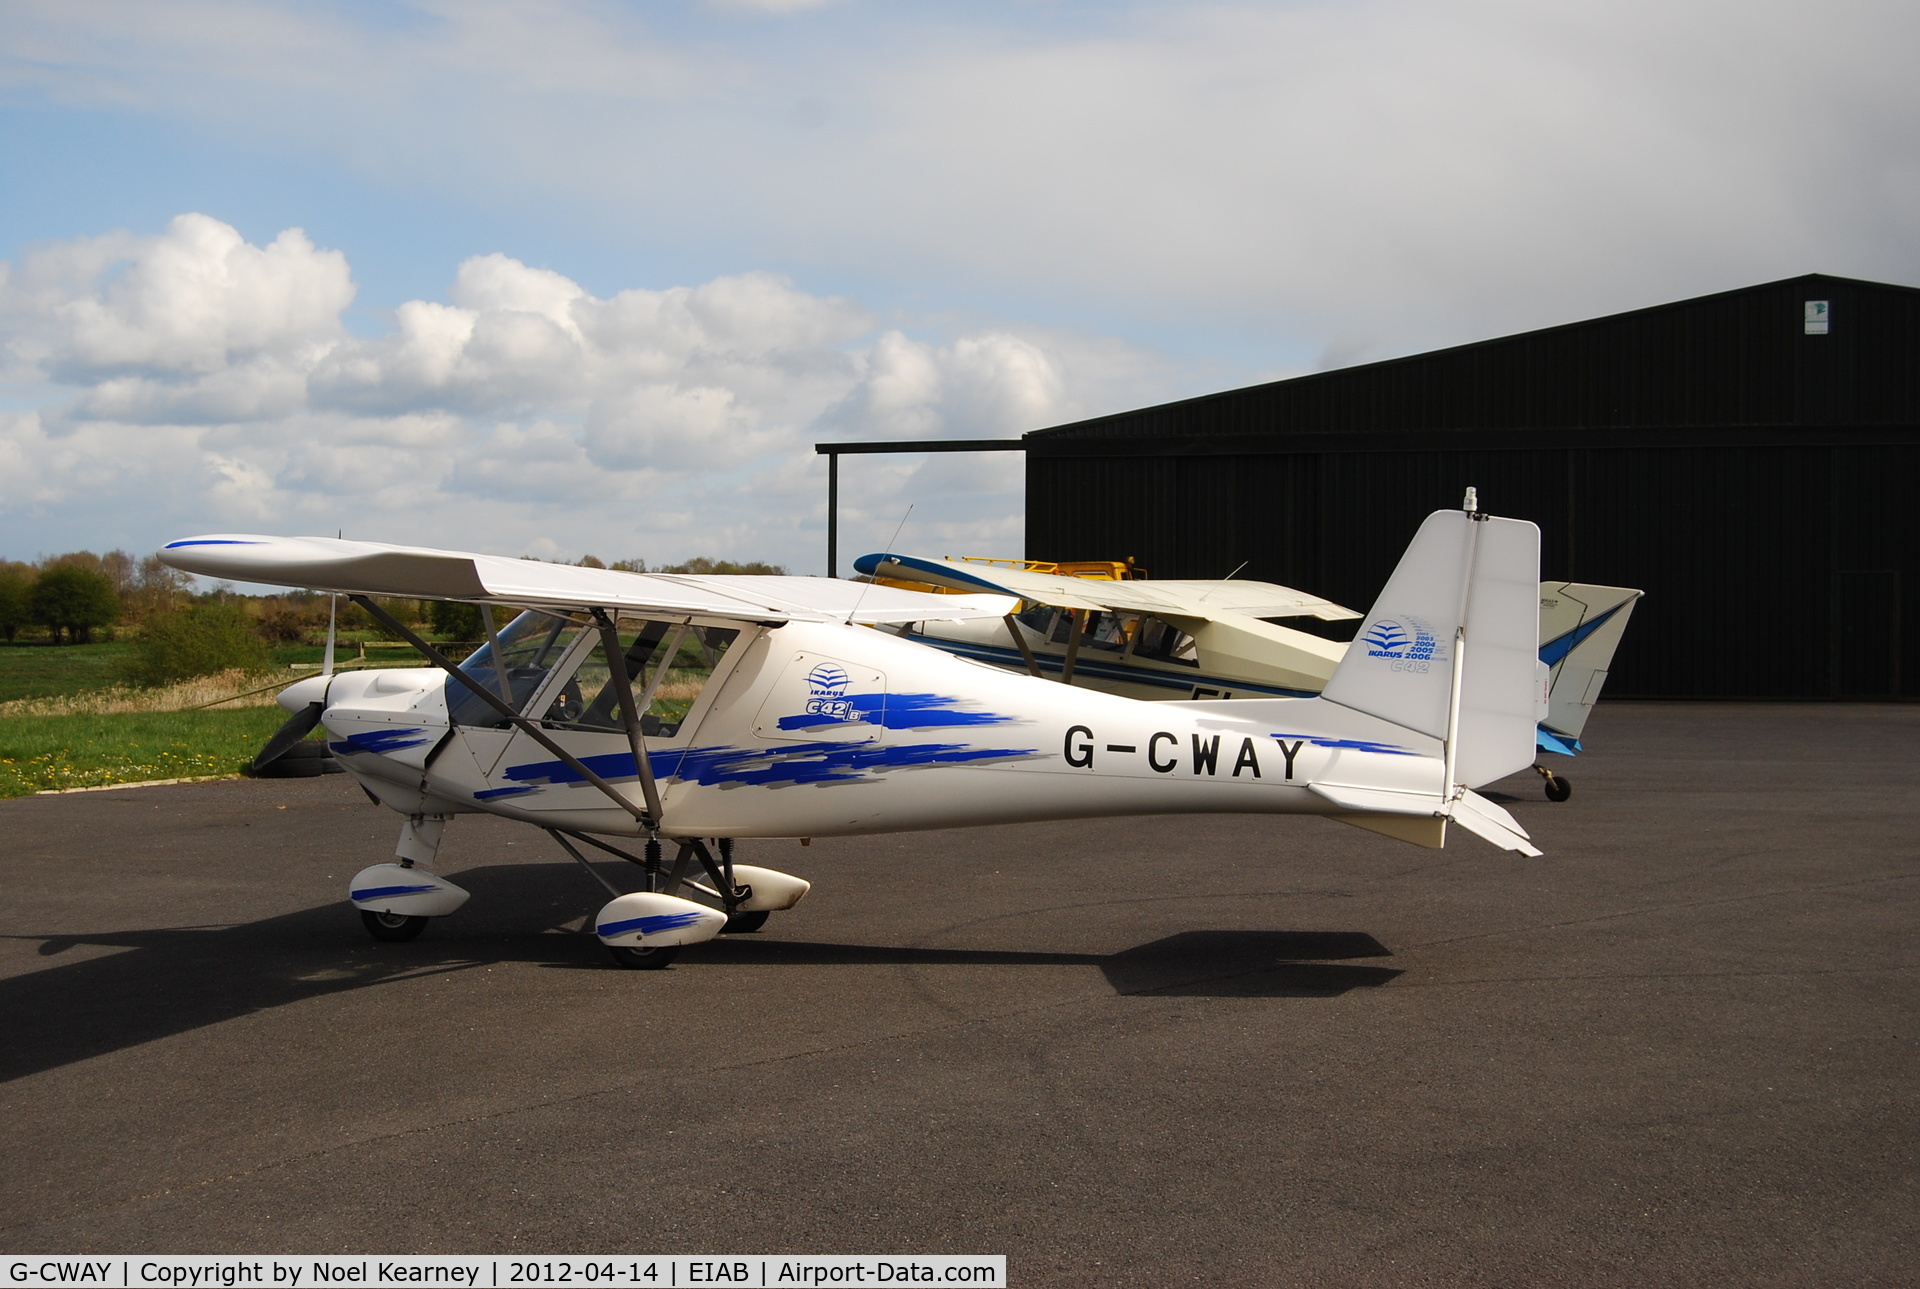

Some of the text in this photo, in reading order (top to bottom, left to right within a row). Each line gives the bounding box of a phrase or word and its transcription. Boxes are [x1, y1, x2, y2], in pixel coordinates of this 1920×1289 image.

[1368, 650, 1403, 659] IKARUS
[1404, 653, 1432, 661] 2006
[1410, 646, 1435, 654] 2005
[1390, 659, 1431, 674] C42
[810, 689, 845, 697] IKARUS
[1064, 725, 1304, 780] G-CWAY
